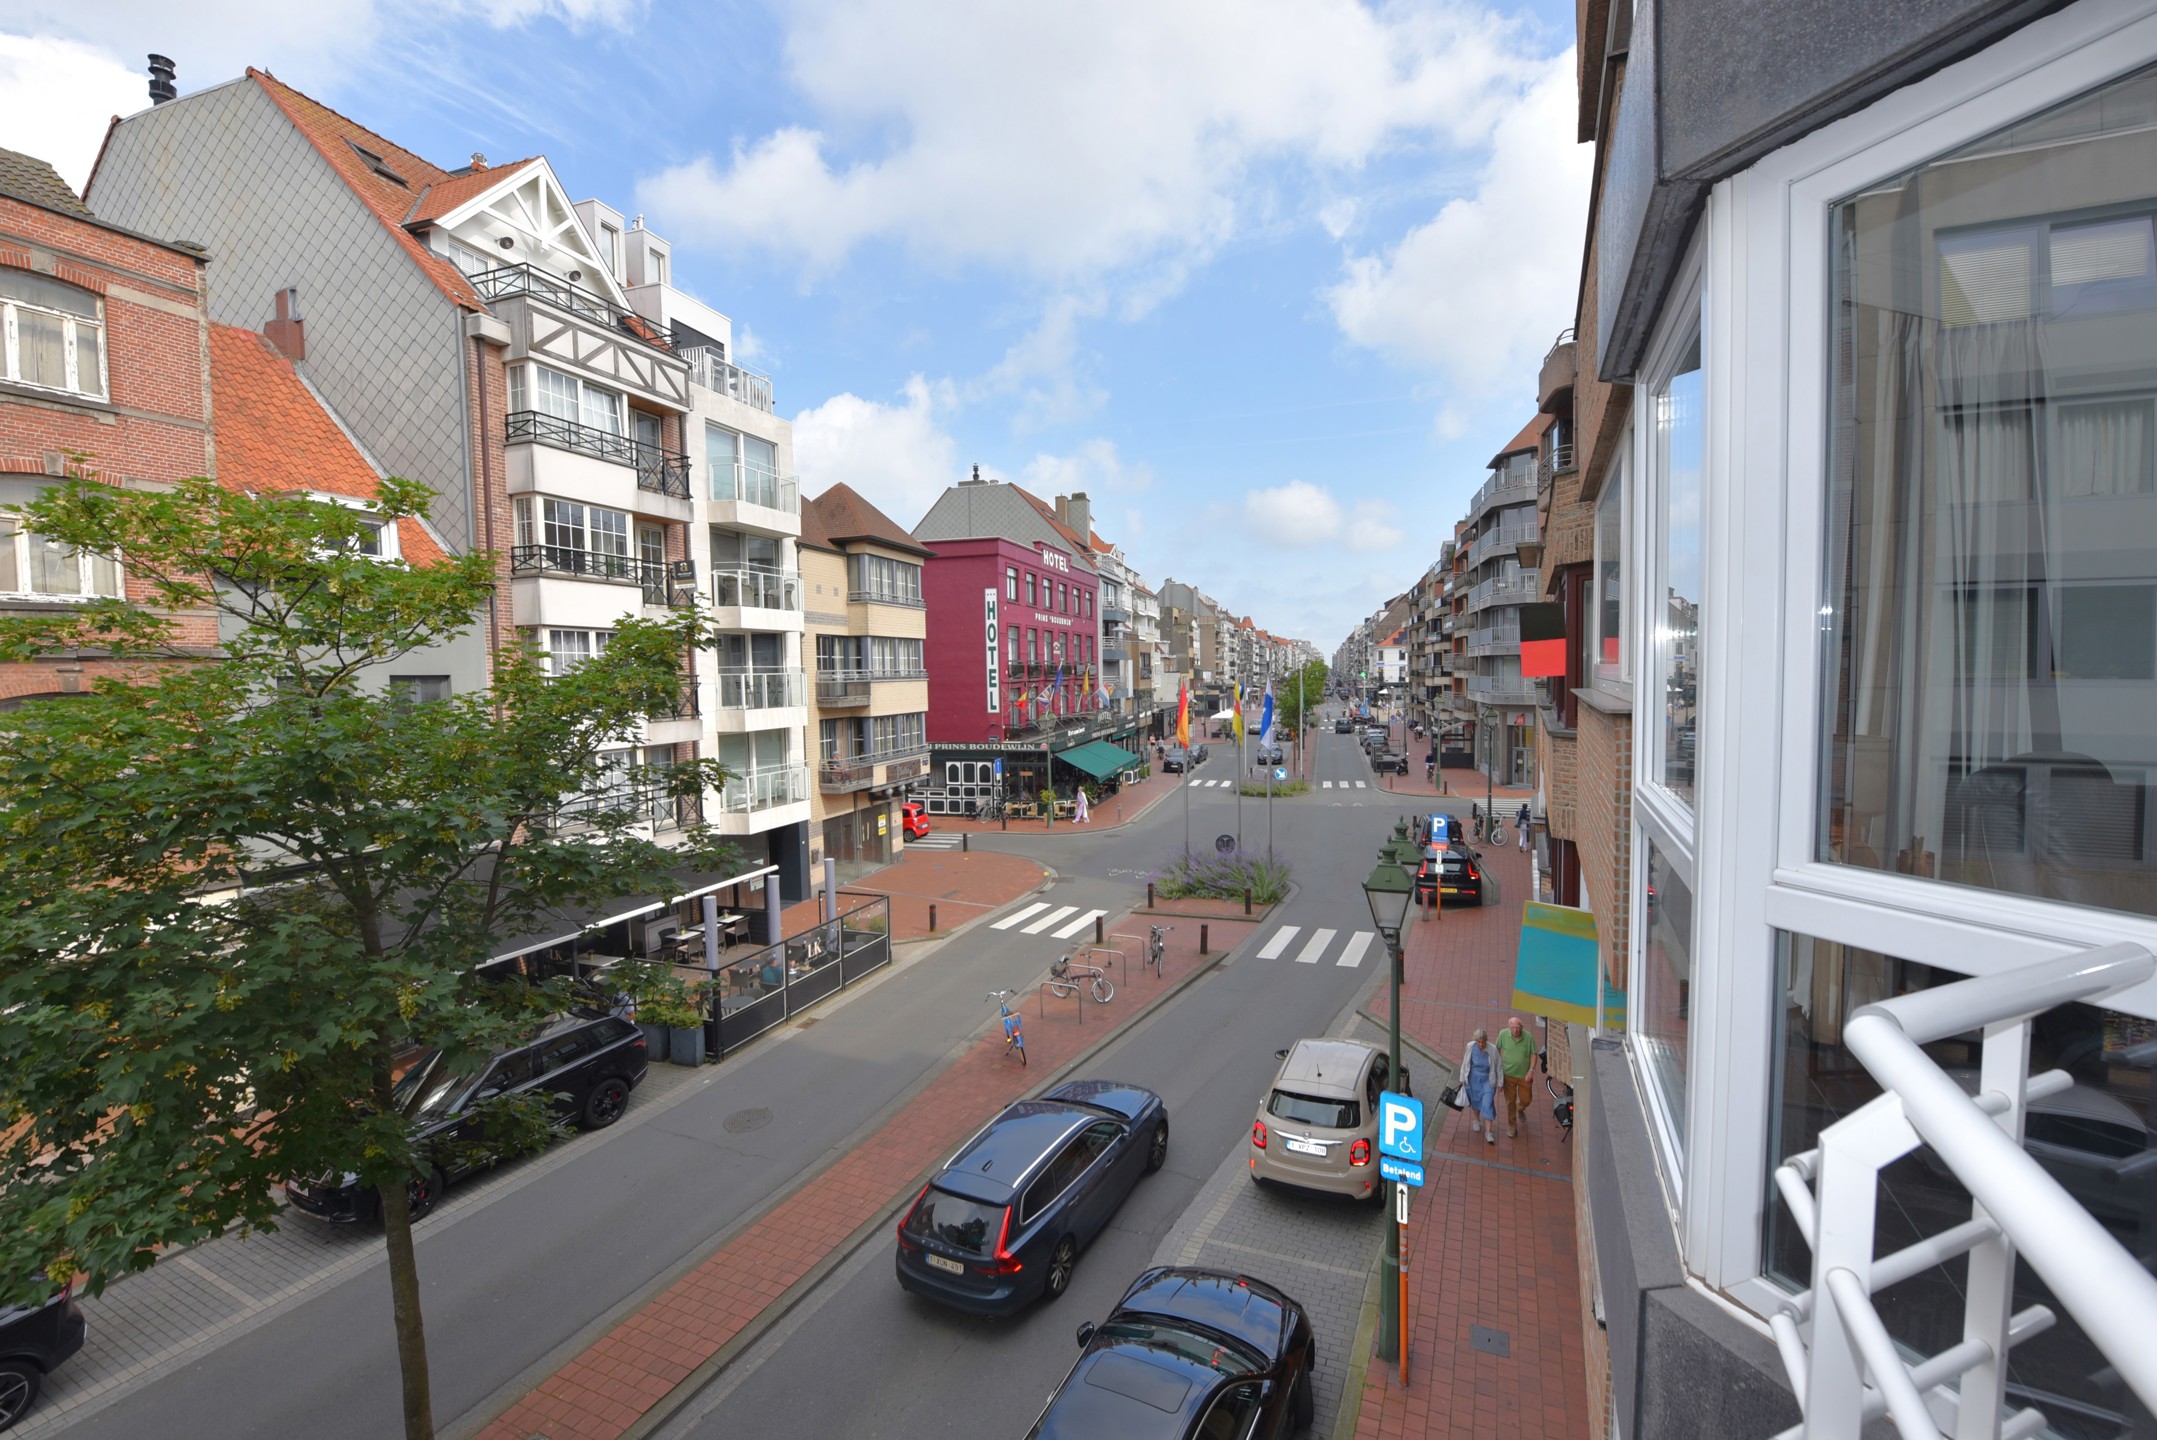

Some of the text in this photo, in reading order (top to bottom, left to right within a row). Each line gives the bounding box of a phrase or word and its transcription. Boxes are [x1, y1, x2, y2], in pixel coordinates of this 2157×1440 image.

[1043, 549, 1069, 573] HOTEL
[1035, 612, 1048, 622] PRINS
[987, 600, 998, 711] HOTEL
[1433, 817, 1445, 832] P
[1385, 1102, 1416, 1146] P
[1382, 1163, 1421, 1180] Betalend
